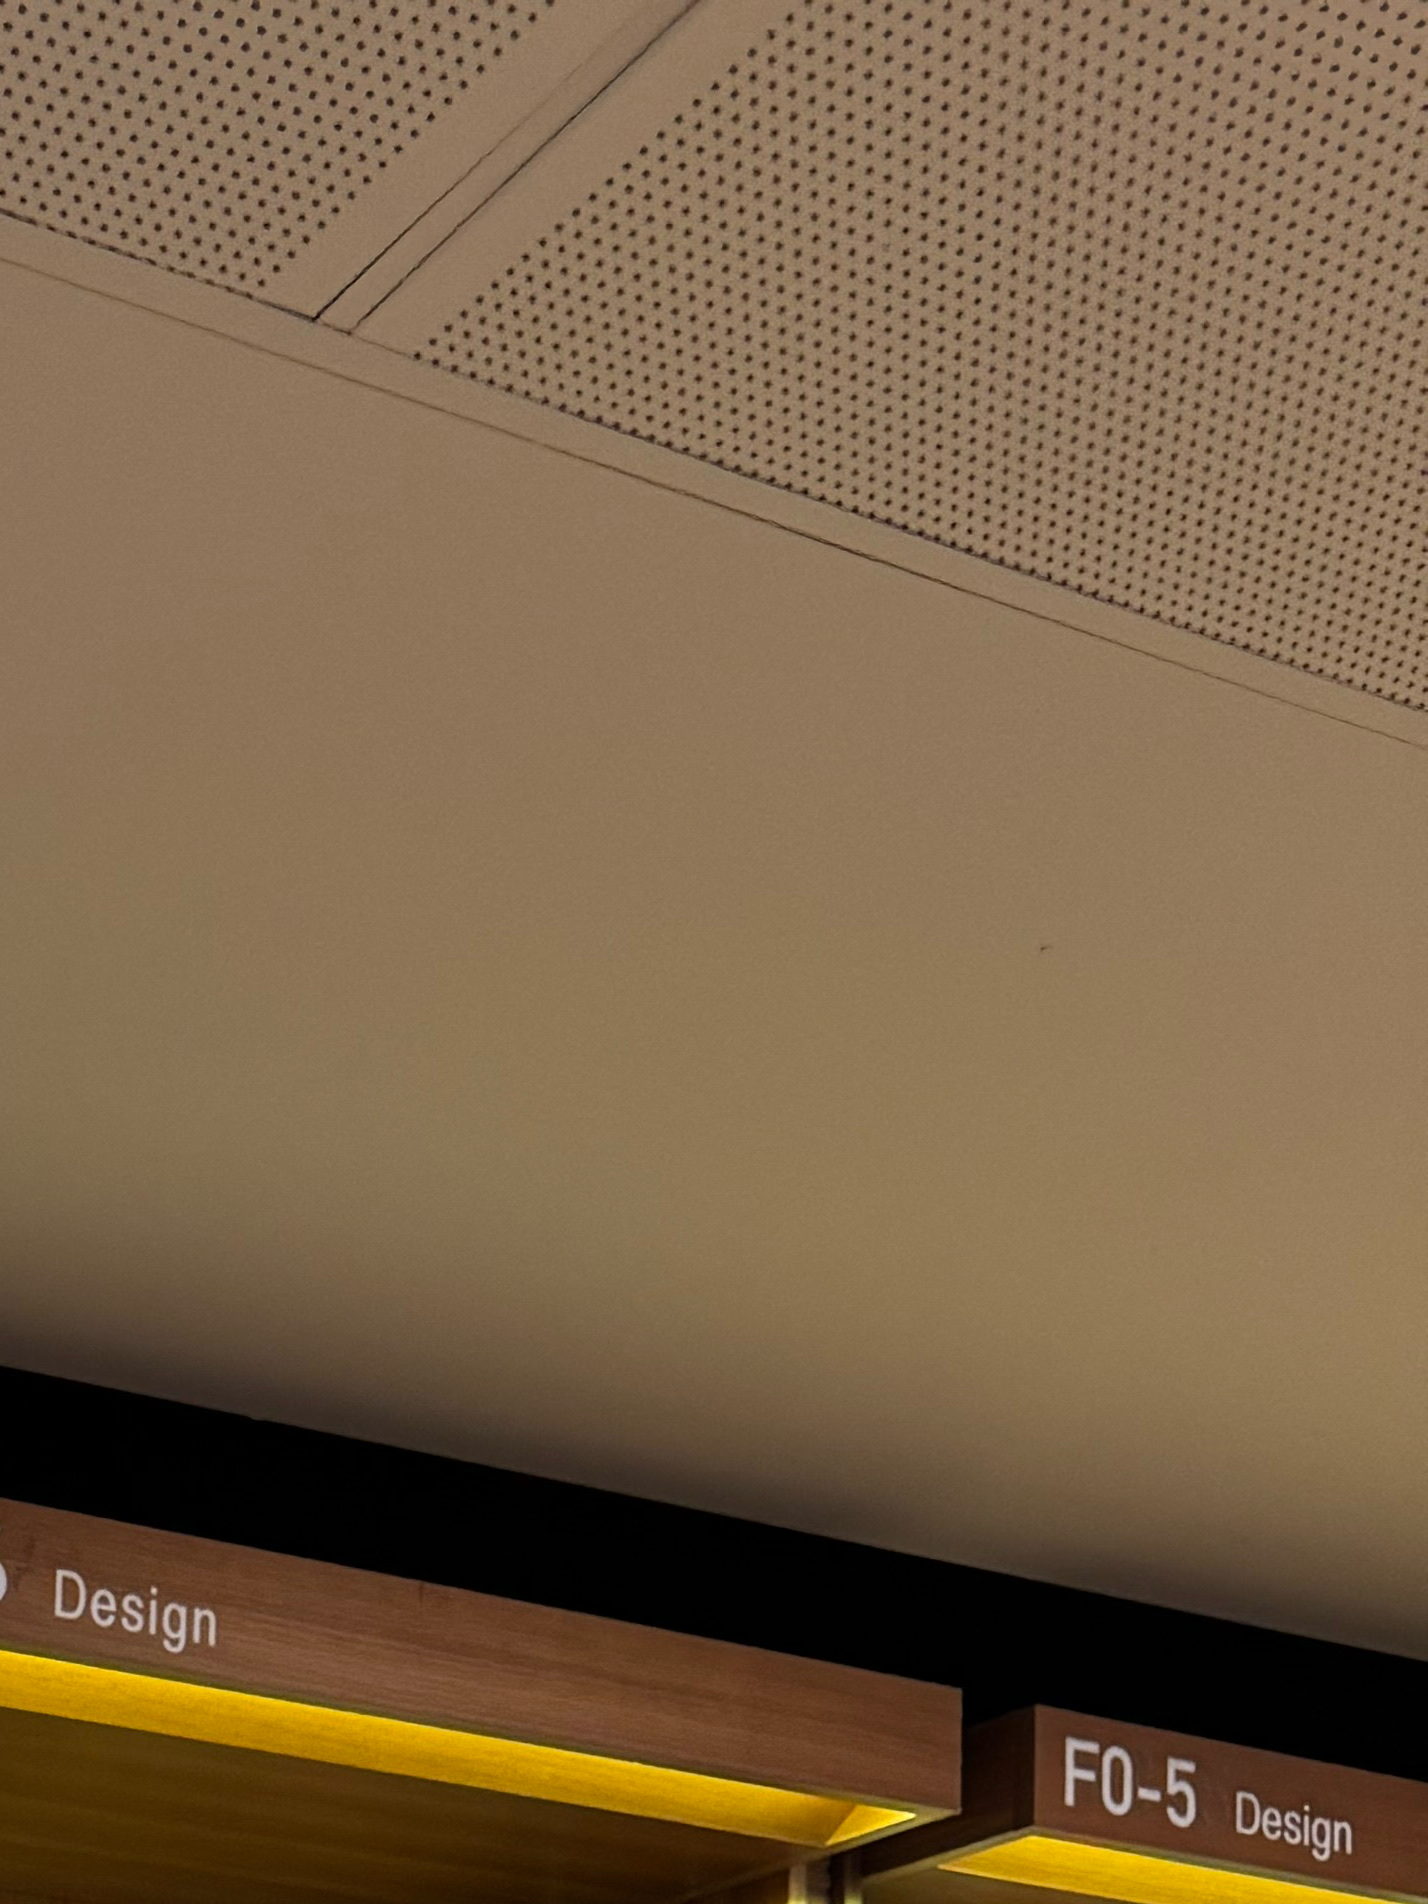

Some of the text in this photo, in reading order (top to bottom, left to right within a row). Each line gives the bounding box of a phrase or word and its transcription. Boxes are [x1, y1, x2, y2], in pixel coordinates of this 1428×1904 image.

[54, 1569, 216, 1653] Design
[1065, 1736, 1352, 1861] F0-5 Design
